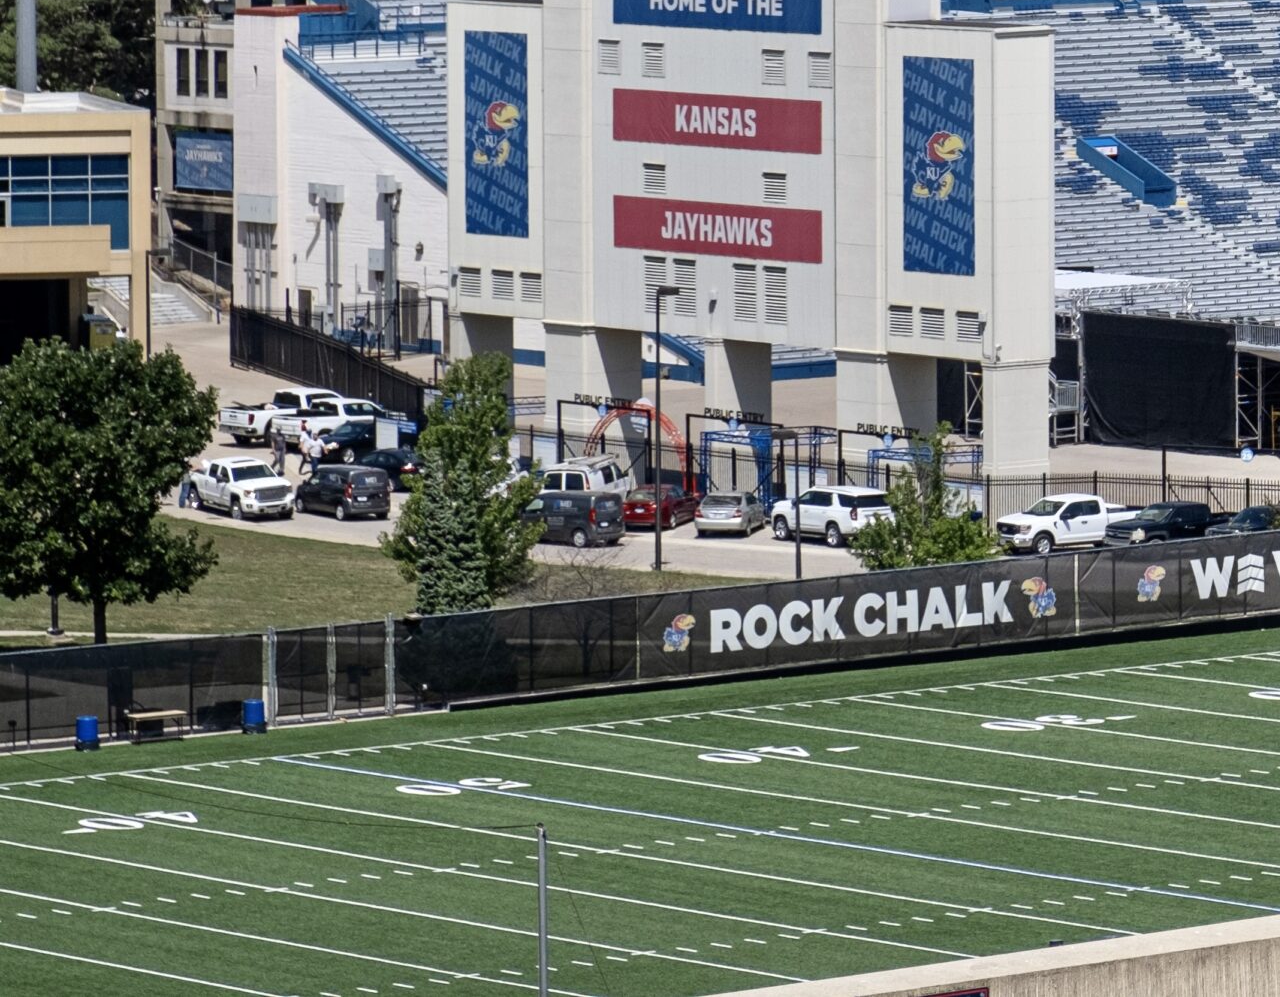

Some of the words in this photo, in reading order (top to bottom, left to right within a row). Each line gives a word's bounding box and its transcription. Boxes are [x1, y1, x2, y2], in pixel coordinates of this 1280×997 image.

[465, 43, 503, 79] CHALK
[930, 58, 967, 90] ROCK
[904, 68, 947, 108] CHALK
[675, 104, 757, 137] KANSAS
[926, 166, 940, 180] KU
[489, 185, 523, 218] ROCK
[661, 211, 773, 247] JAYHAWKS
[930, 220, 967, 256] ROCK
[904, 233, 947, 272] CHALK
[704, 407, 733, 419] PUBLIC
[857, 423, 888, 434] PUBLIC
[710, 596, 845, 653] ROCK
[854, 580, 1014, 637] CHALK
